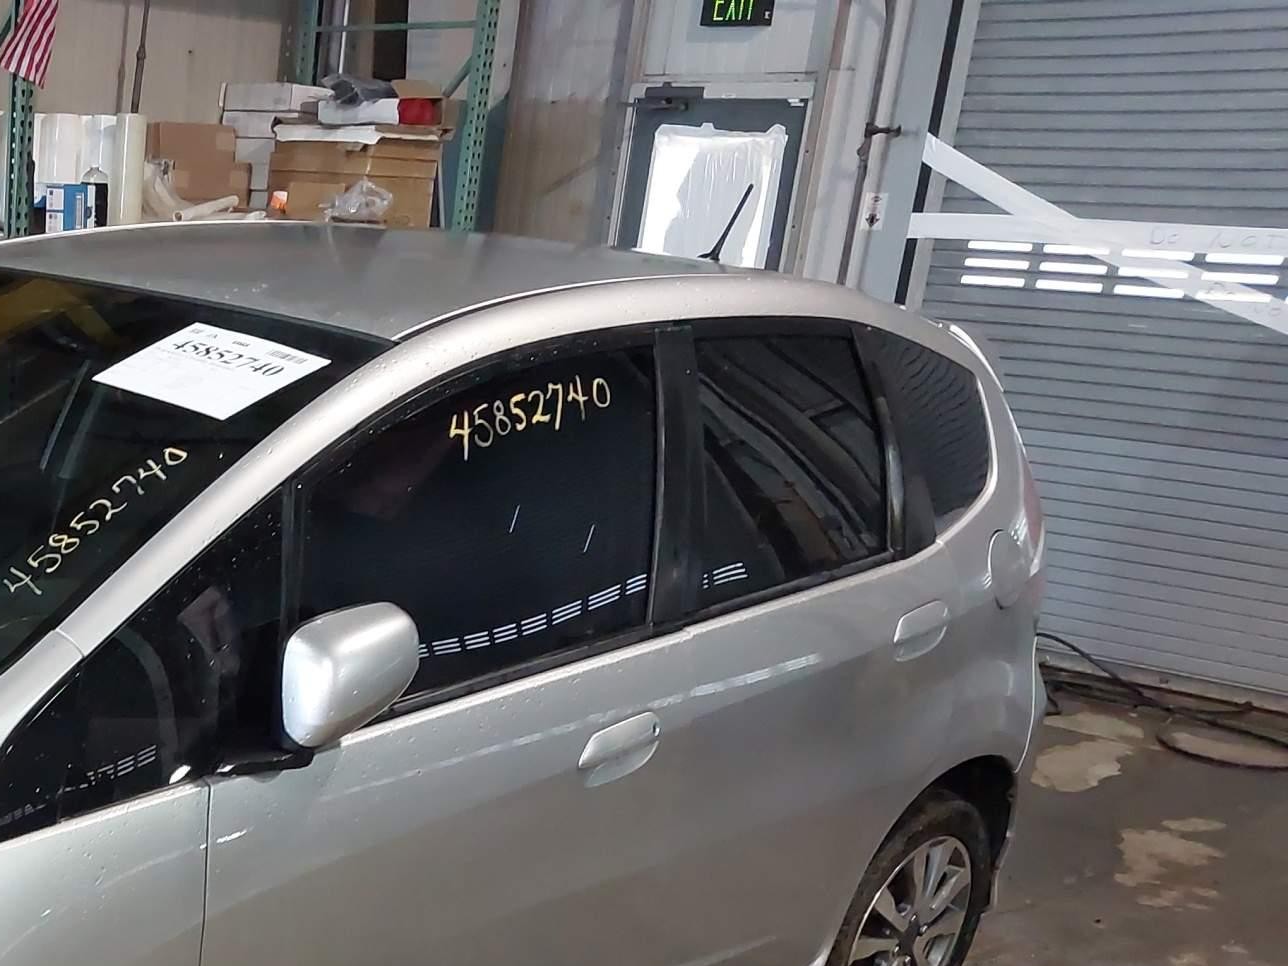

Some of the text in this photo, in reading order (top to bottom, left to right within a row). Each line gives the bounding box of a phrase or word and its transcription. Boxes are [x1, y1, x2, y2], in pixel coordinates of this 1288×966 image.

[172, 339, 285, 377] 45852740
[448, 374, 611, 461] 45852740
[3, 447, 188, 595] 45852740
